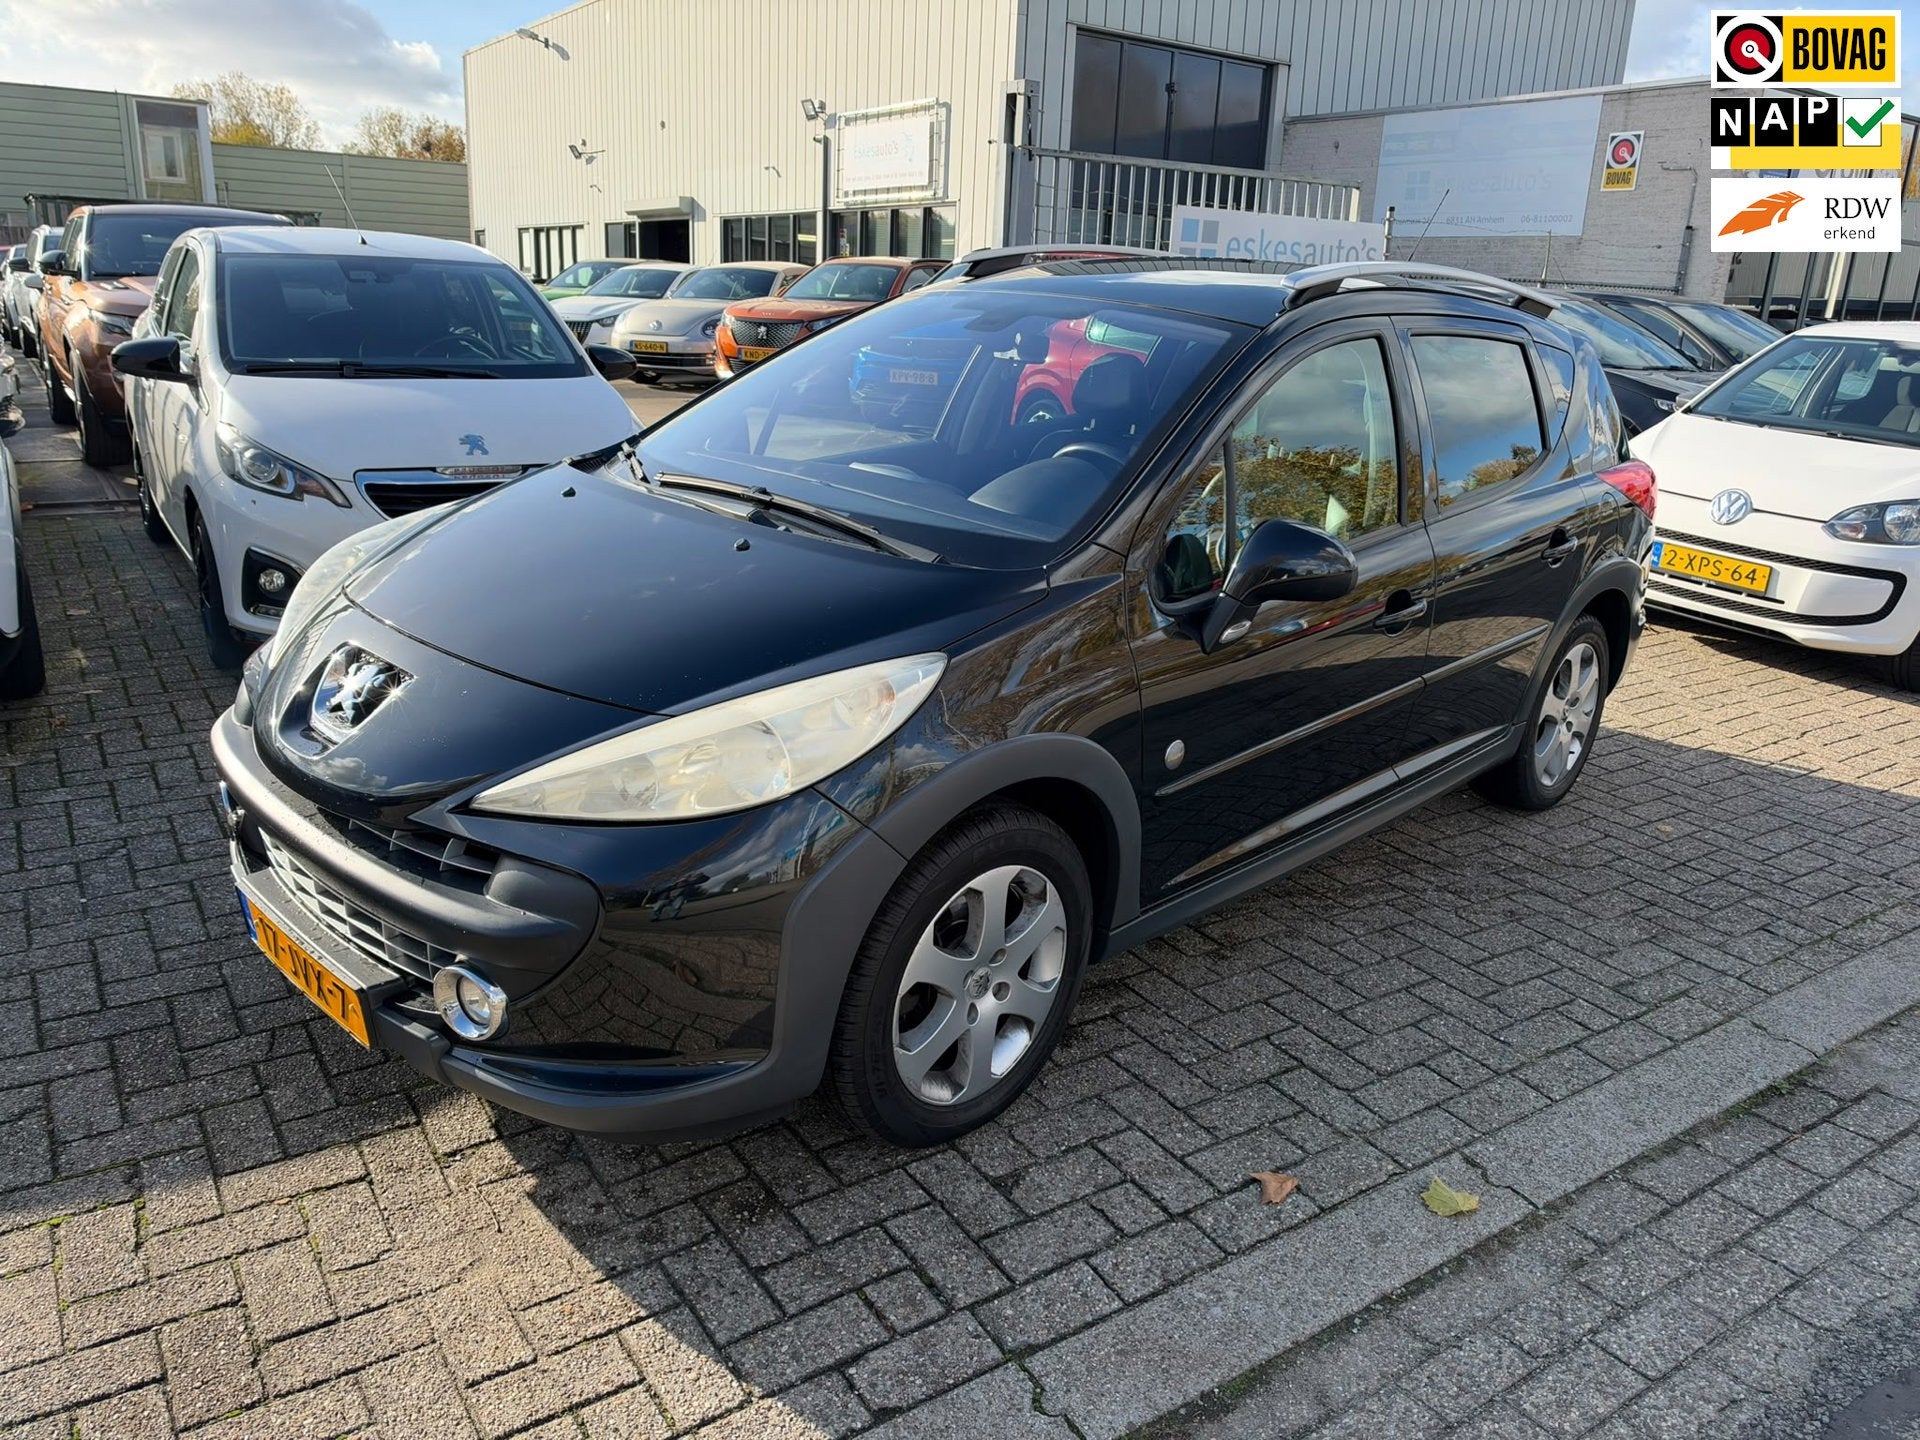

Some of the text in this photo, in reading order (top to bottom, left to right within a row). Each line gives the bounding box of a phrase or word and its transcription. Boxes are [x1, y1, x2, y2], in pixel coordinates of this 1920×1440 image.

[1605, 171, 1632, 185] BOVAG
[1226, 228, 1378, 265] eskesauto's
[1666, 549, 1758, 585] 2-XPS-64
[258, 916, 347, 1020] 17-JVX-7
